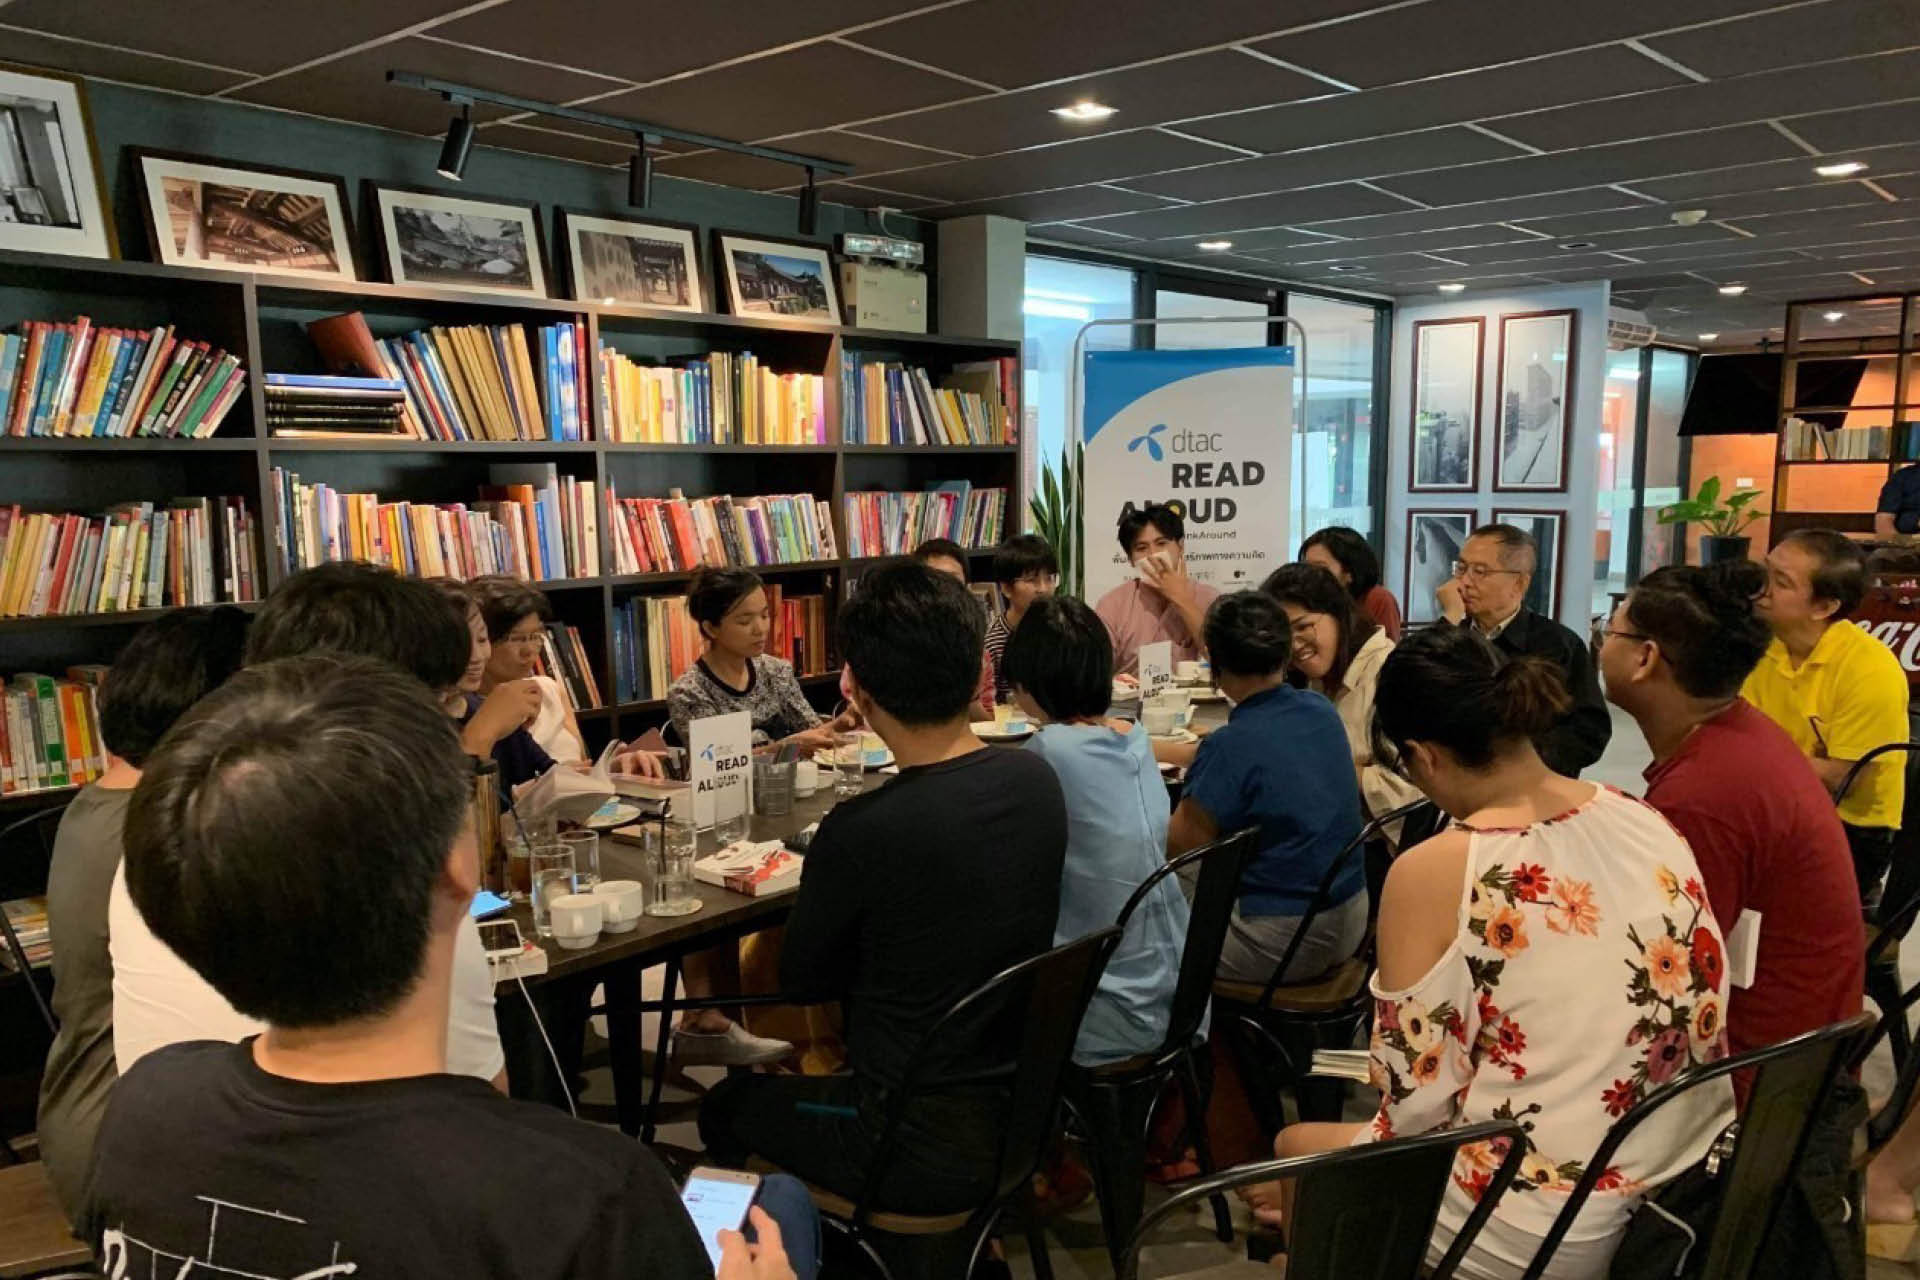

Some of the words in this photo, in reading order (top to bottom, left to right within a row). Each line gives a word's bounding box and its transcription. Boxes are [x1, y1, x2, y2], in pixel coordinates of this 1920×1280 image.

[1171, 428, 1223, 454] dtac
[1171, 461, 1266, 489] READ
[1117, 498, 1237, 526] AOUD
[715, 755, 749, 772] READ
